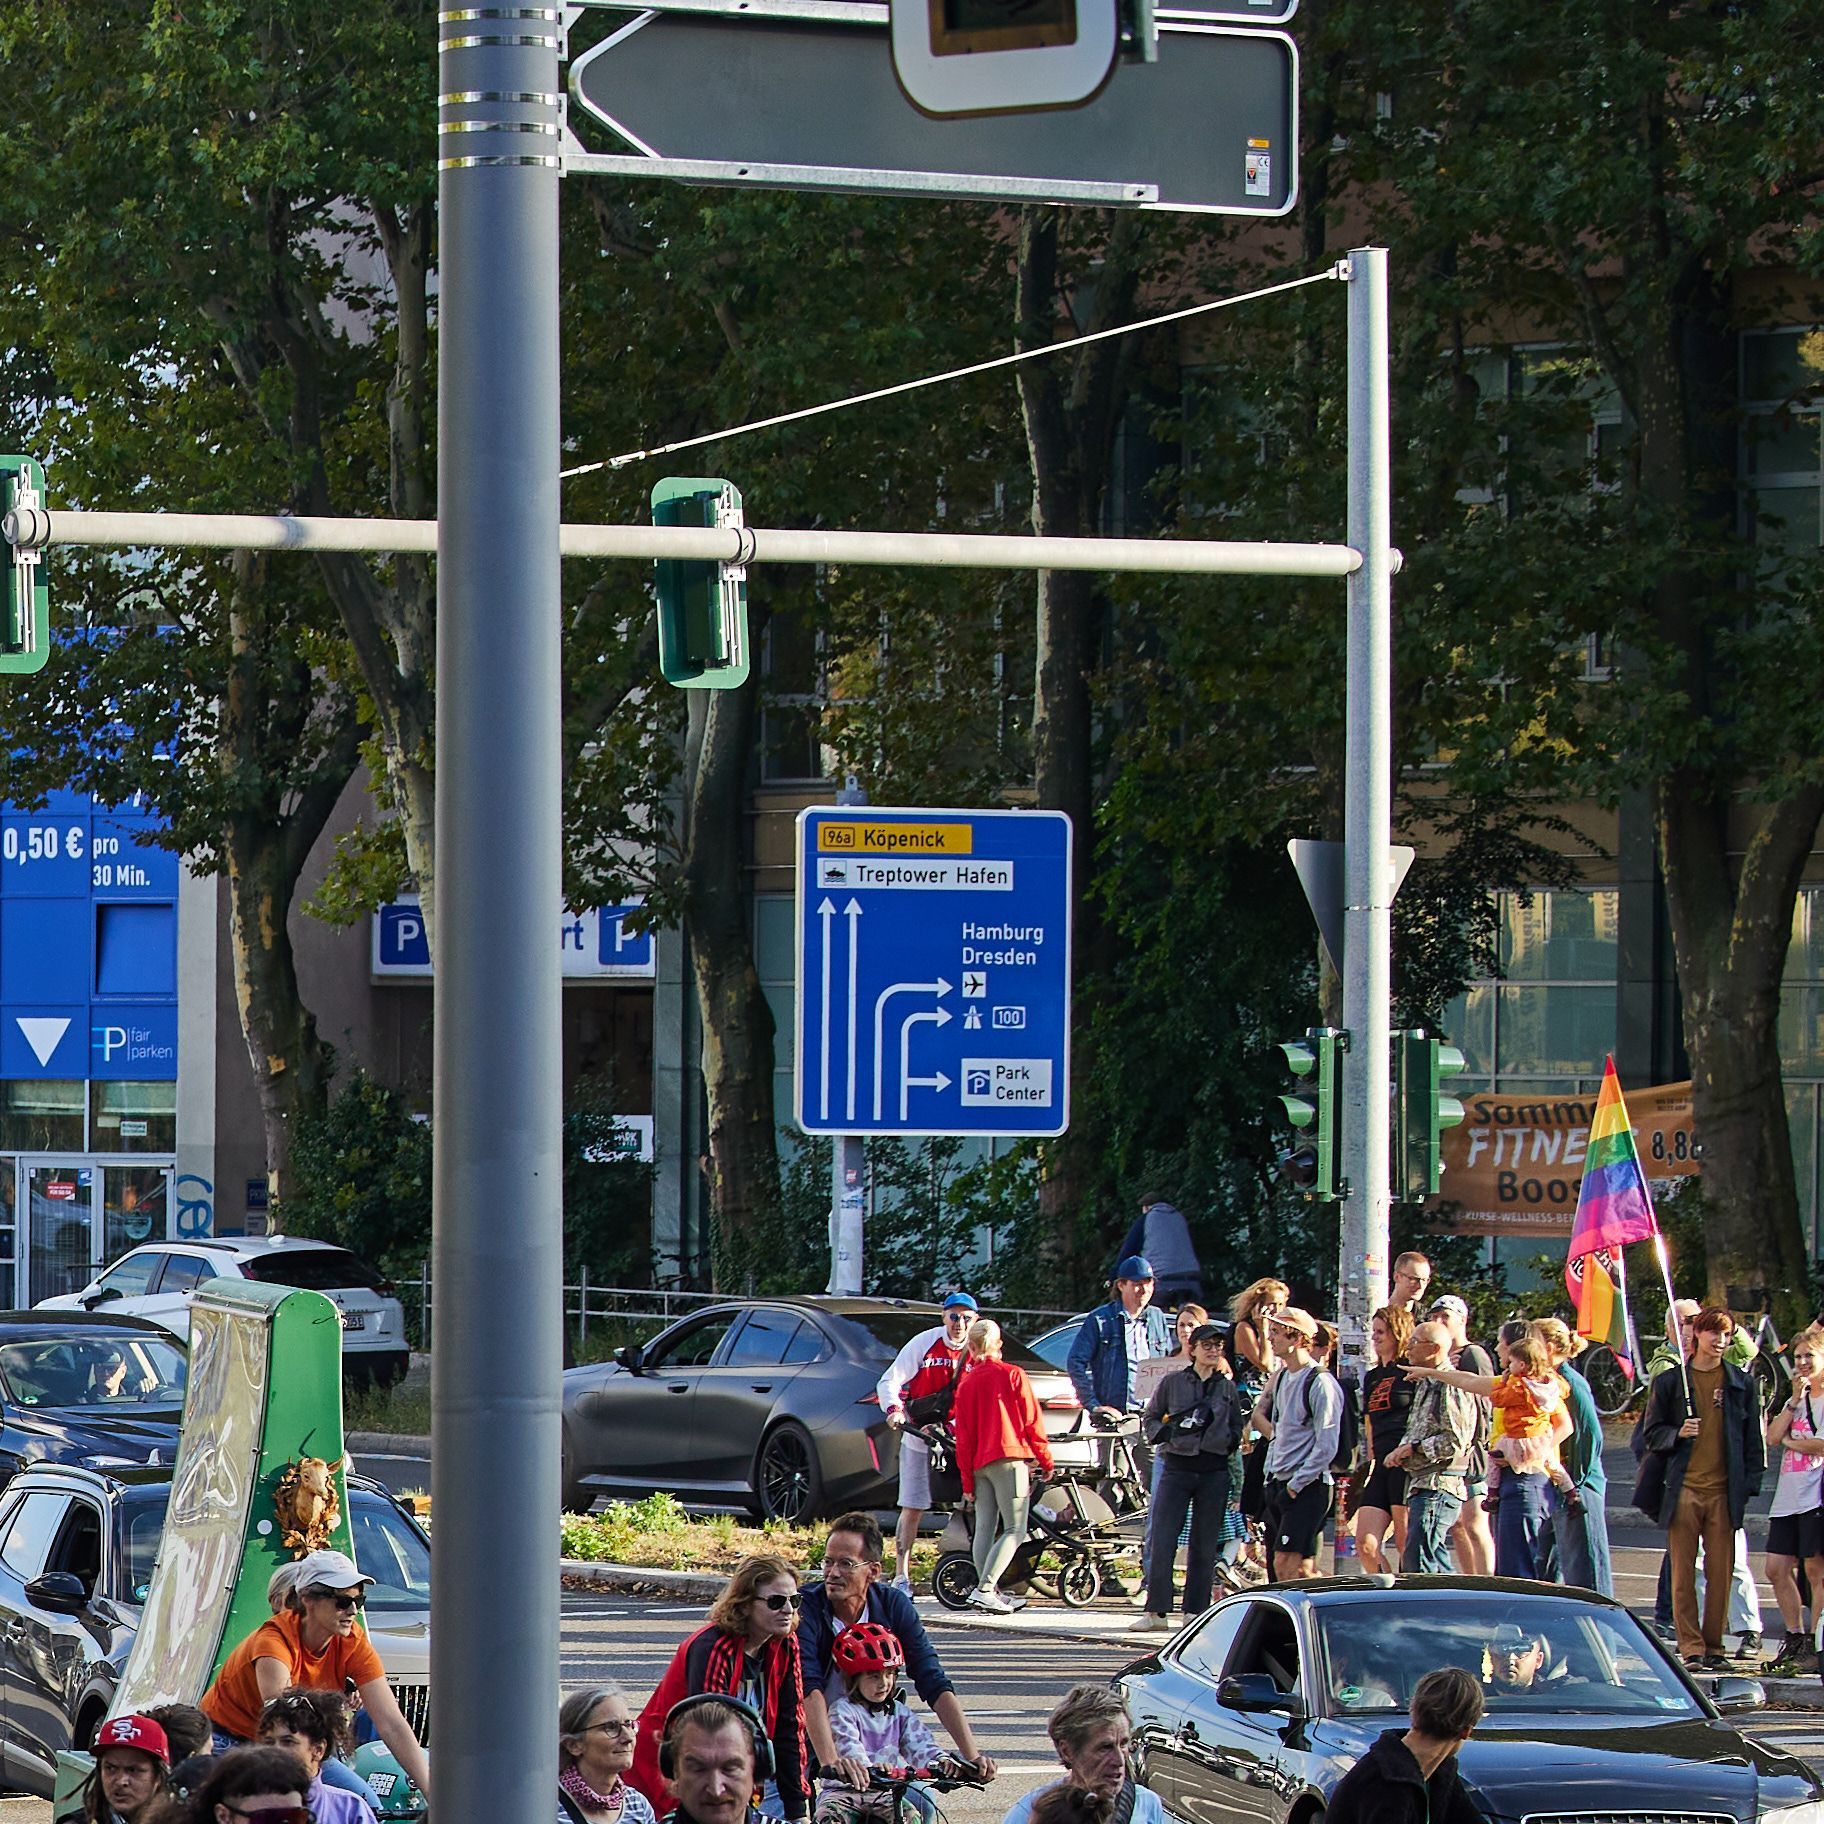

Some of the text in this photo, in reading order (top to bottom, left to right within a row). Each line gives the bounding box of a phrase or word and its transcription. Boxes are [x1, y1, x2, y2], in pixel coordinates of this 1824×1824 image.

[3, 826, 84, 866] 0,50 €
[827, 831, 851, 844] 96a
[864, 829, 945, 850] Köpenick
[93, 837, 119, 860] pro
[92, 864, 151, 887] 30 Min.
[856, 865, 1008, 886] Treptower Hafen
[962, 922, 1044, 945] Hamburg
[962, 946, 1037, 965] Dresden
[998, 1011, 1020, 1024] 100
[130, 1028, 151, 1043] fair
[131, 1045, 174, 1062] parken
[996, 1065, 1030, 1080] Park
[996, 1086, 1046, 1100] Center
